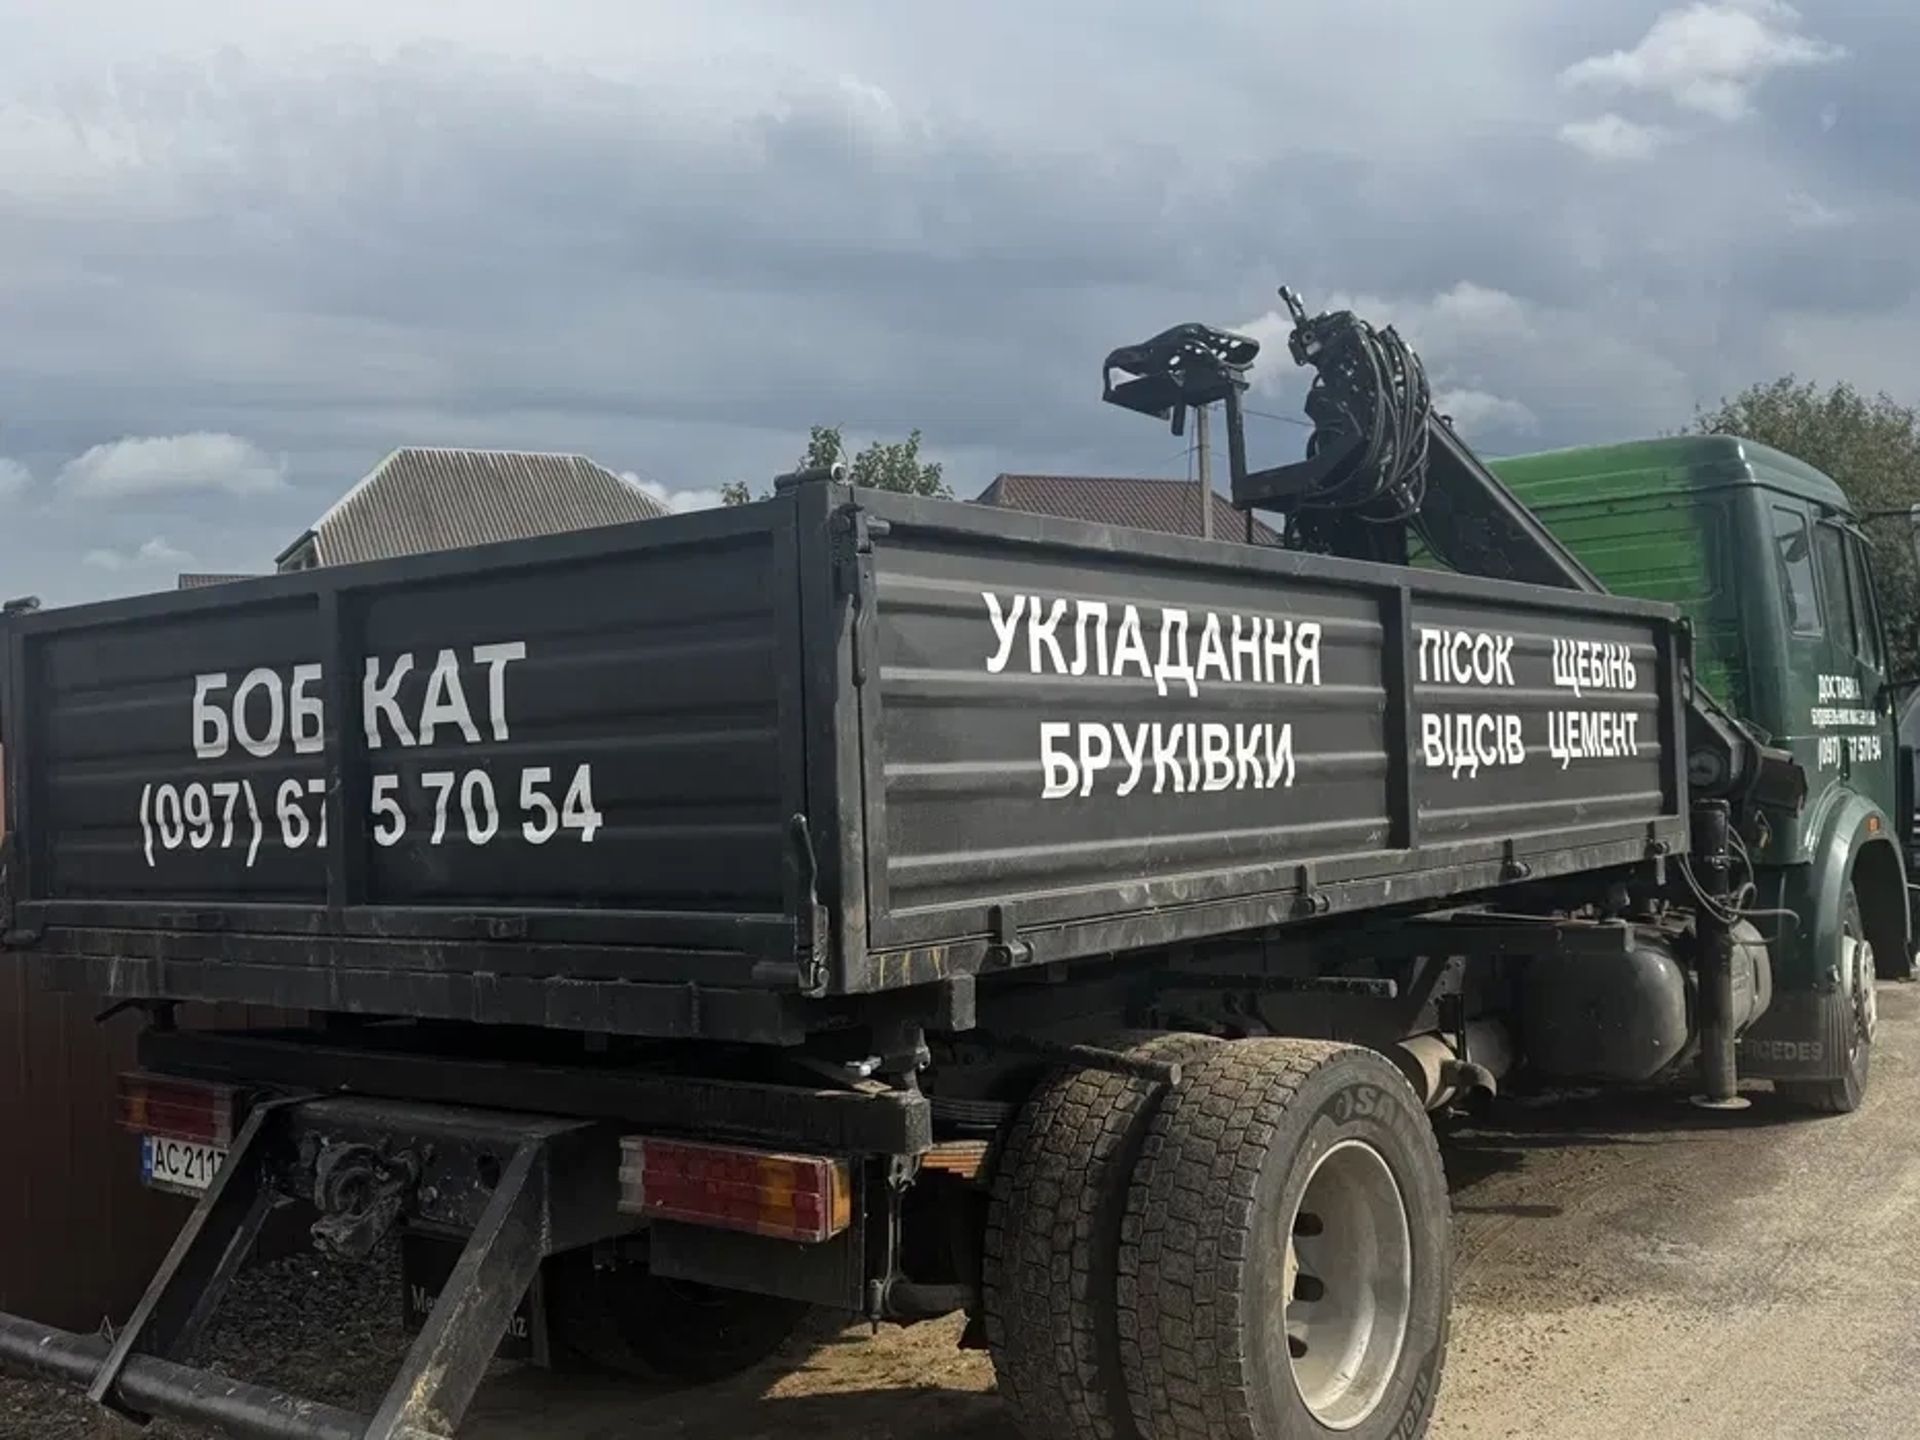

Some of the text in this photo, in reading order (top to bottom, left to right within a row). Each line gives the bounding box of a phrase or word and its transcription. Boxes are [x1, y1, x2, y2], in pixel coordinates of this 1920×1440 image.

[980, 592, 1322, 698] УКЛАДАННЯ
[1419, 628, 1637, 698] ПІСОК ЩЕБІНЬ
[1040, 722, 1296, 800] БРУКІВКИ
[1421, 711, 1639, 779] ВІДСІВ ЦЕМЕНТ
[140, 779, 262, 867] (097)
[421, 768, 499, 846] 70
[520, 763, 603, 844] 54
